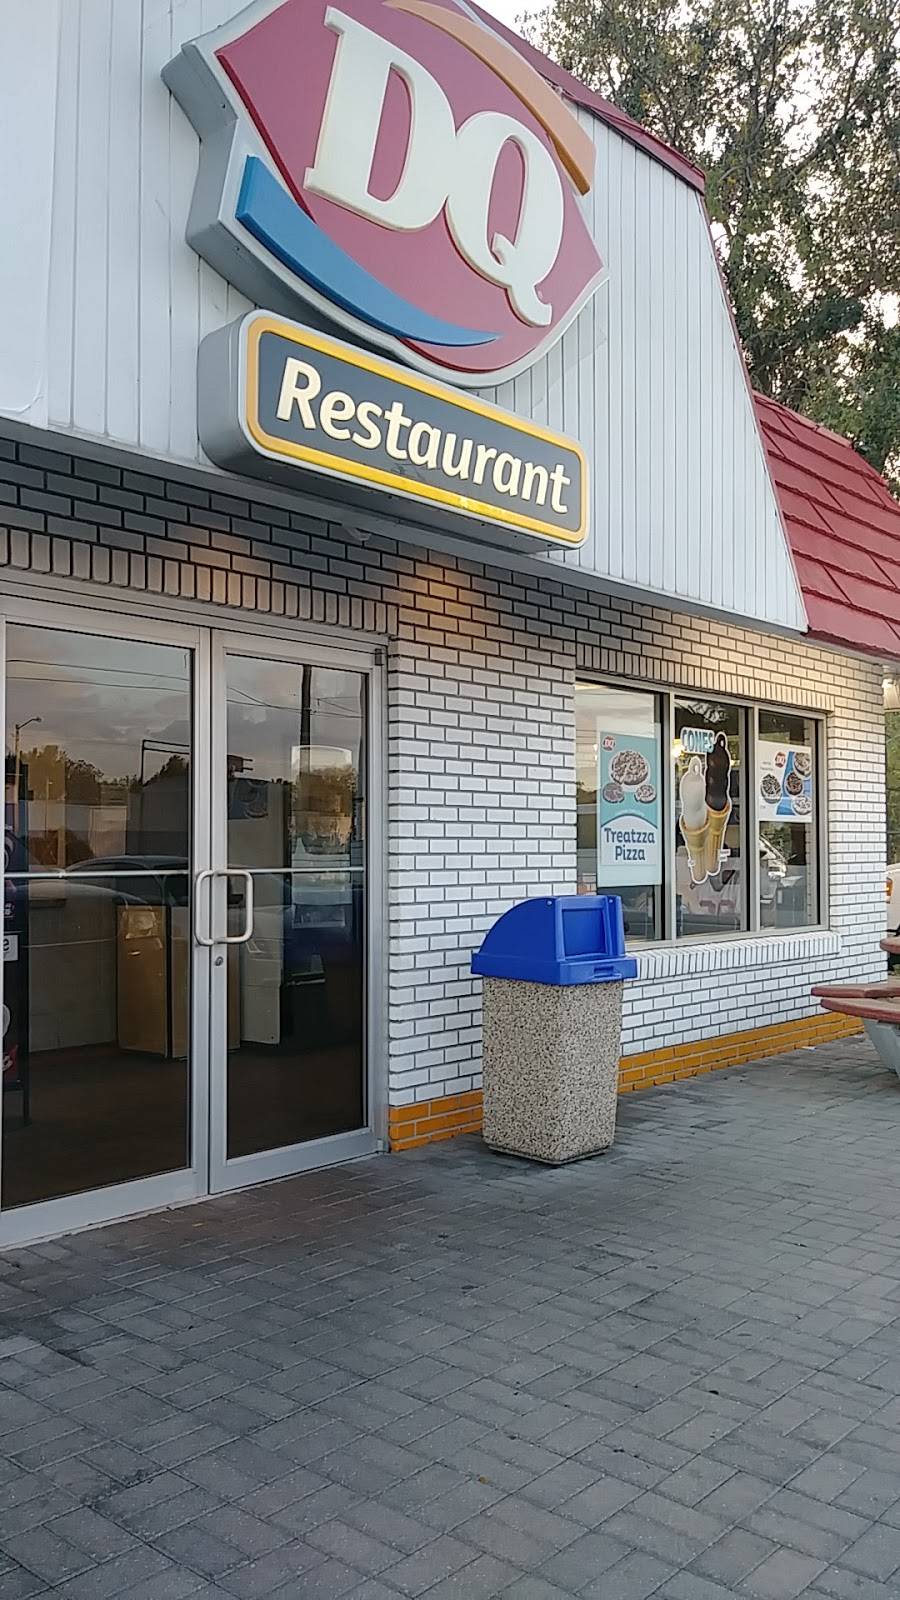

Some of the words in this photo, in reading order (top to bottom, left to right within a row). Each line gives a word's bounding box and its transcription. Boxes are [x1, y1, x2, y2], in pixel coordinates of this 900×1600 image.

[304, 5, 564, 328] DQ
[275, 356, 570, 514] Restaurant
[682, 729, 714, 753] CONES
[604, 827, 655, 844] Treatzza
[615, 845, 645, 861] Pizza
